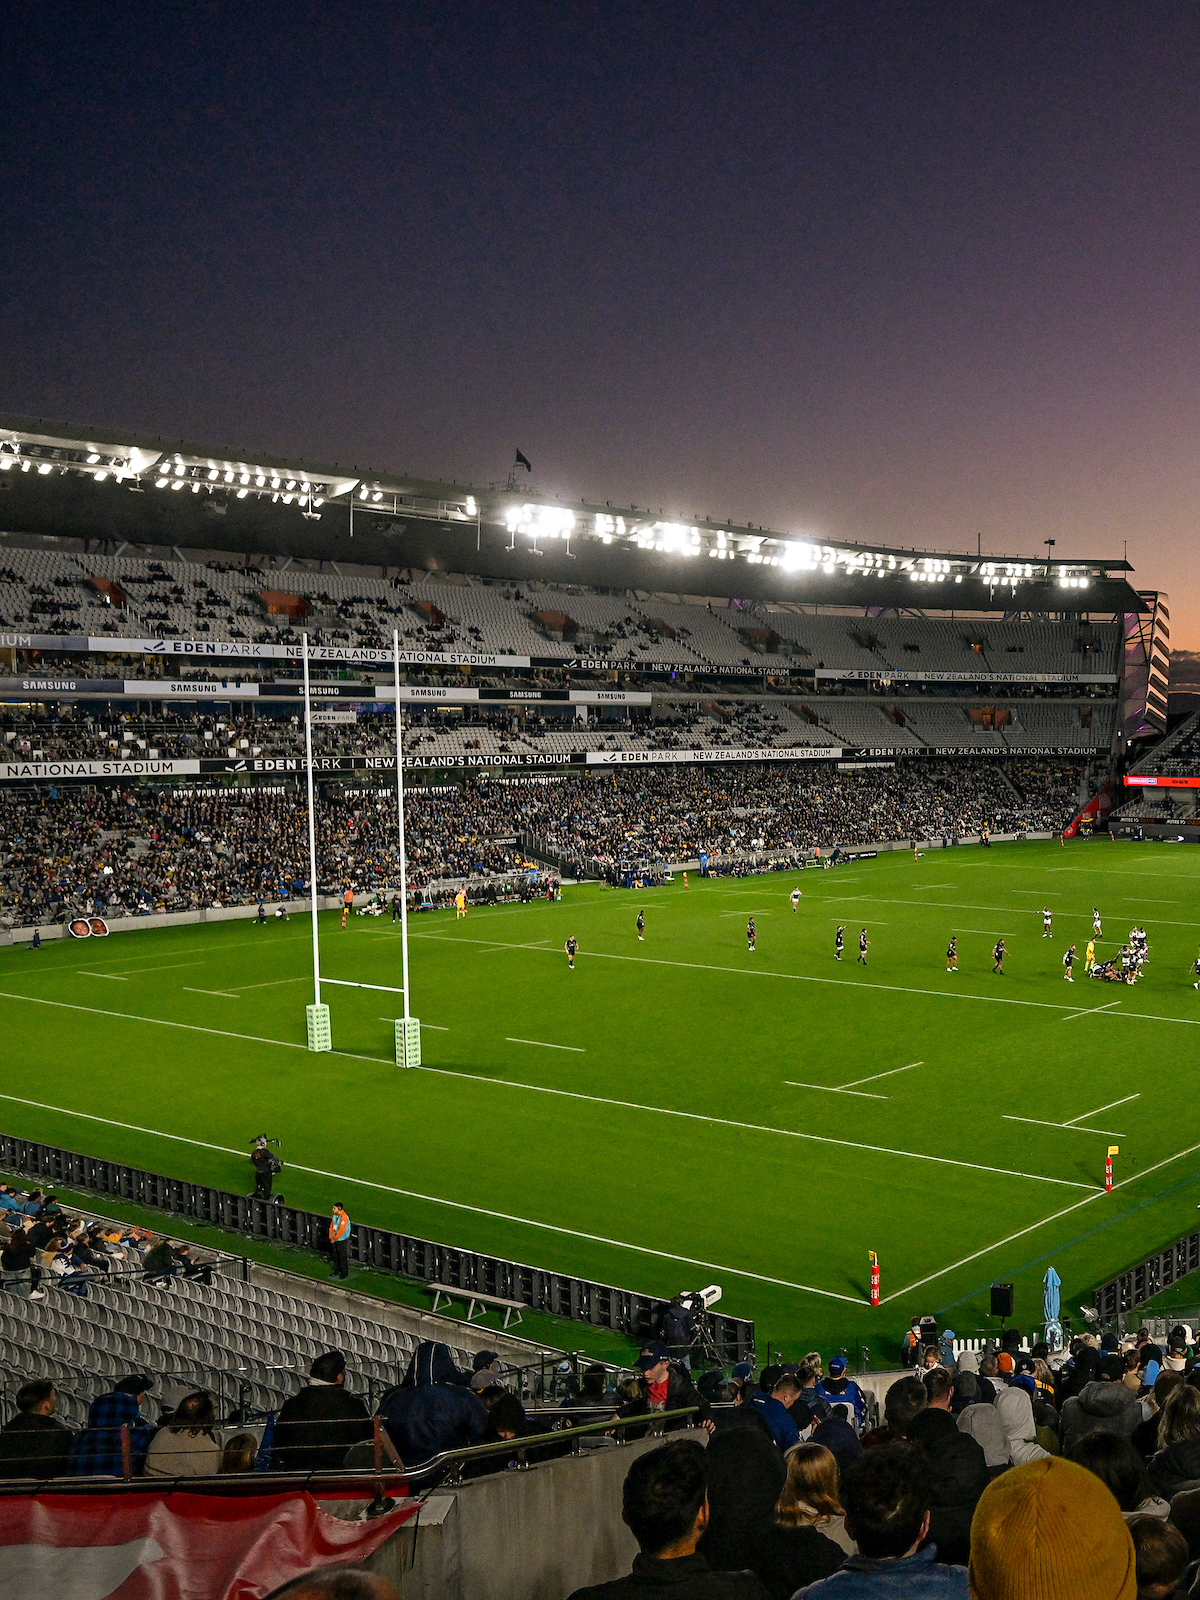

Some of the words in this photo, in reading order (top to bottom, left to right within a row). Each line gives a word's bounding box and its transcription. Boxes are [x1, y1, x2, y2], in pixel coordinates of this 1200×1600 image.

[173, 642, 216, 653] EDEN
[221, 643, 261, 656] PARK
[286, 648, 316, 658] NEW
[320, 648, 387, 660] ZEALAND'S
[450, 654, 496, 664] STADIUM
[581, 659, 609, 670] EDEN
[610, 660, 636, 670] PARK
[652, 663, 672, 672] NEW
[673, 664, 718, 674] ZEALAND'S
[719, 665, 756, 675] NATIONAL
[758, 666, 790, 676] STADIUM
[884, 671, 910, 679] PARK
[924, 672, 945, 680] NEW
[946, 672, 994, 680] ZEALAND'S
[996, 673, 1036, 681] NATIONAL
[1038, 674, 1079, 682] STADIUM
[22, 681, 76, 690] SAMSUNG
[170, 684, 217, 692] SAMSUNG
[298, 686, 340, 695] SMSUNG
[622, 752, 648, 761] EDEN
[651, 752, 678, 760] PARK
[694, 751, 713, 760] NEW
[714, 750, 760, 760] ZEALAND'S
[762, 750, 798, 758] NATIONAL
[800, 749, 831, 758] STADIUM
[870, 748, 894, 756] EDEN
[896, 748, 920, 756] PARK
[254, 759, 297, 770] EDEN
[301, 758, 341, 770] PARK
[366, 758, 396, 768] NEW
[400, 756, 465, 767] ZEALAND'S
[468, 755, 523, 766] NATIONAL
[526, 754, 571, 764] STADIUM
[8, 764, 98, 777] NATIONAL
[103, 762, 174, 775] STADIUM
